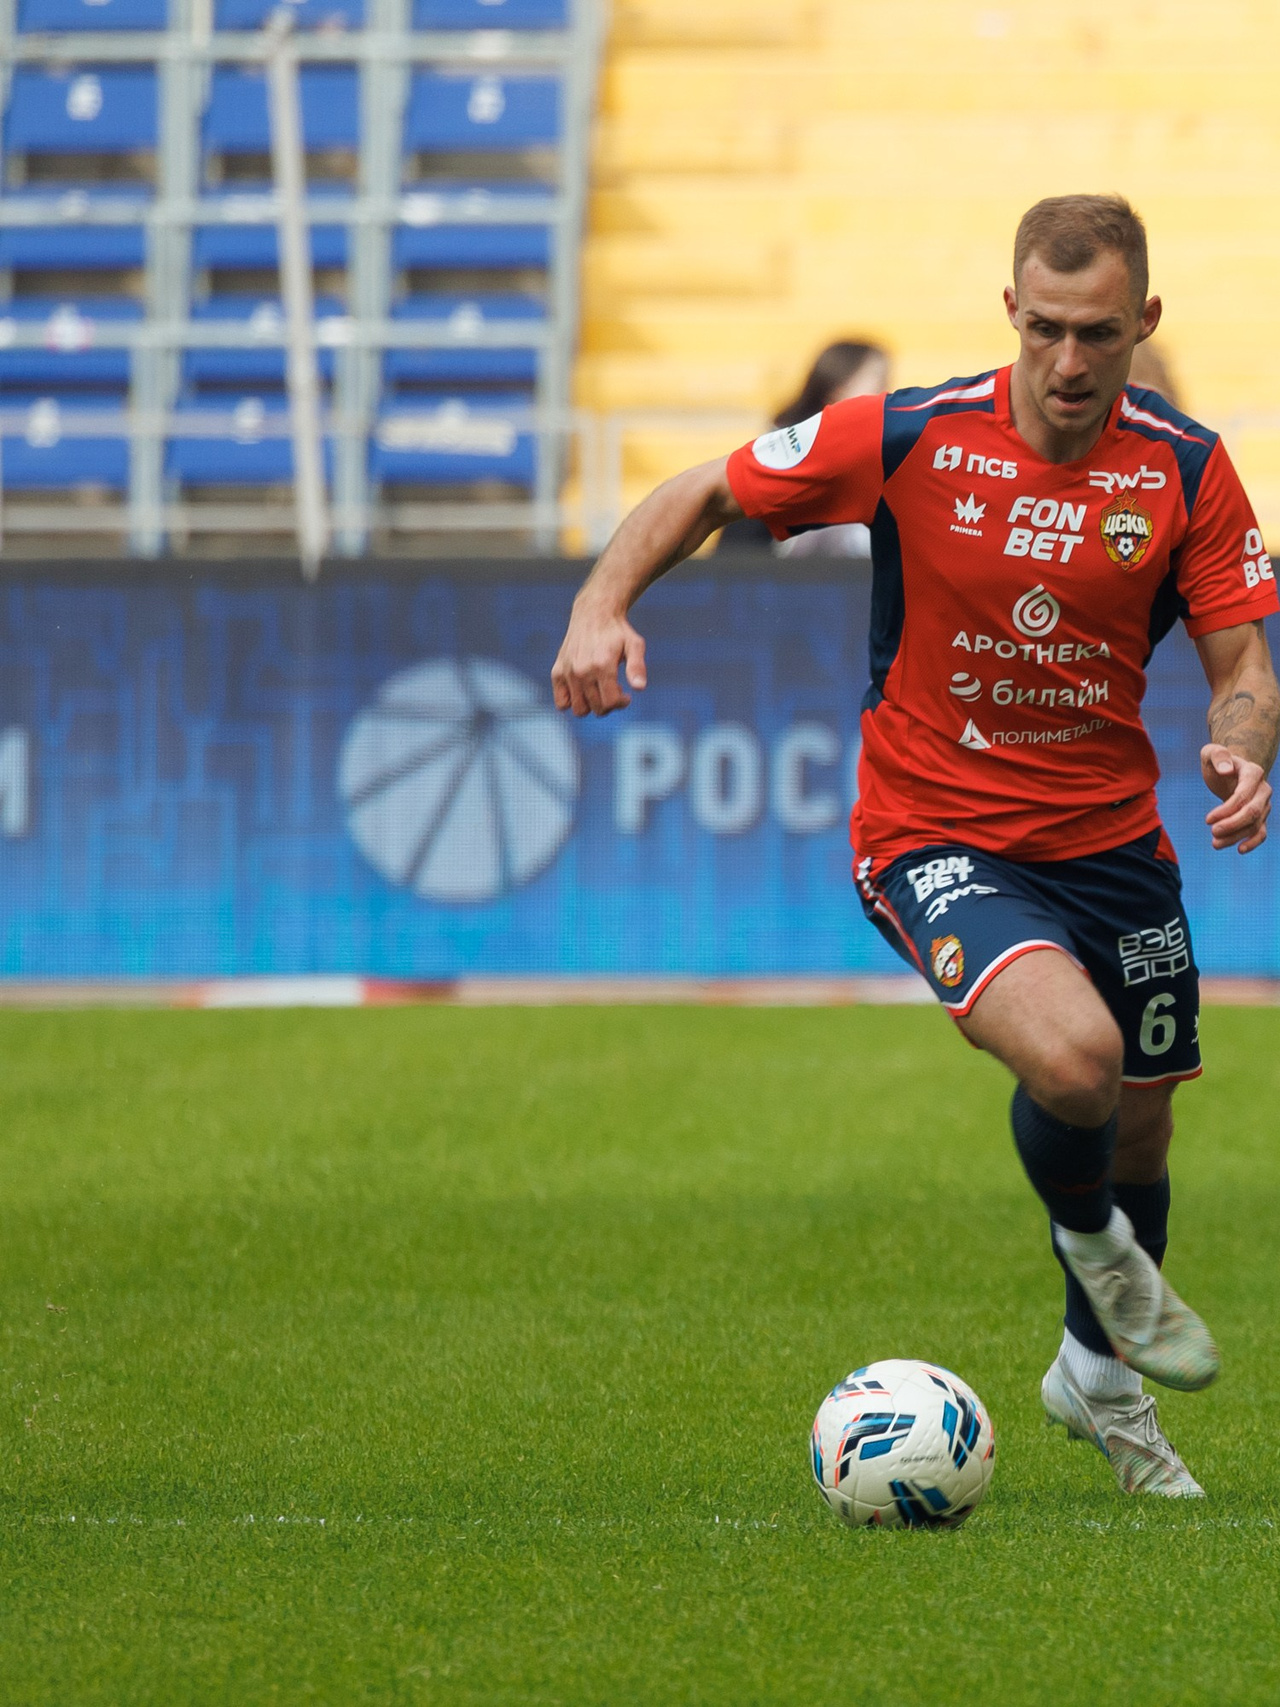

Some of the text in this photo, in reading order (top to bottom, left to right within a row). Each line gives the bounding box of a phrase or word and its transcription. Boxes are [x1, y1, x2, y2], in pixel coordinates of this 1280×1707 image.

[966, 453, 1018, 479] ПСБ
[950, 524, 983, 537] PRIMERA
[1007, 496, 1087, 532] FON
[1104, 514, 1149, 536] ЦСКА
[1003, 527, 1084, 563] BET
[952, 631, 1111, 664] APOTHEKA
[992, 679, 1108, 708] билайн
[914, 866, 974, 903] BET
[1118, 917, 1184, 958] ВЭБ
[1139, 992, 1176, 1056] 6
